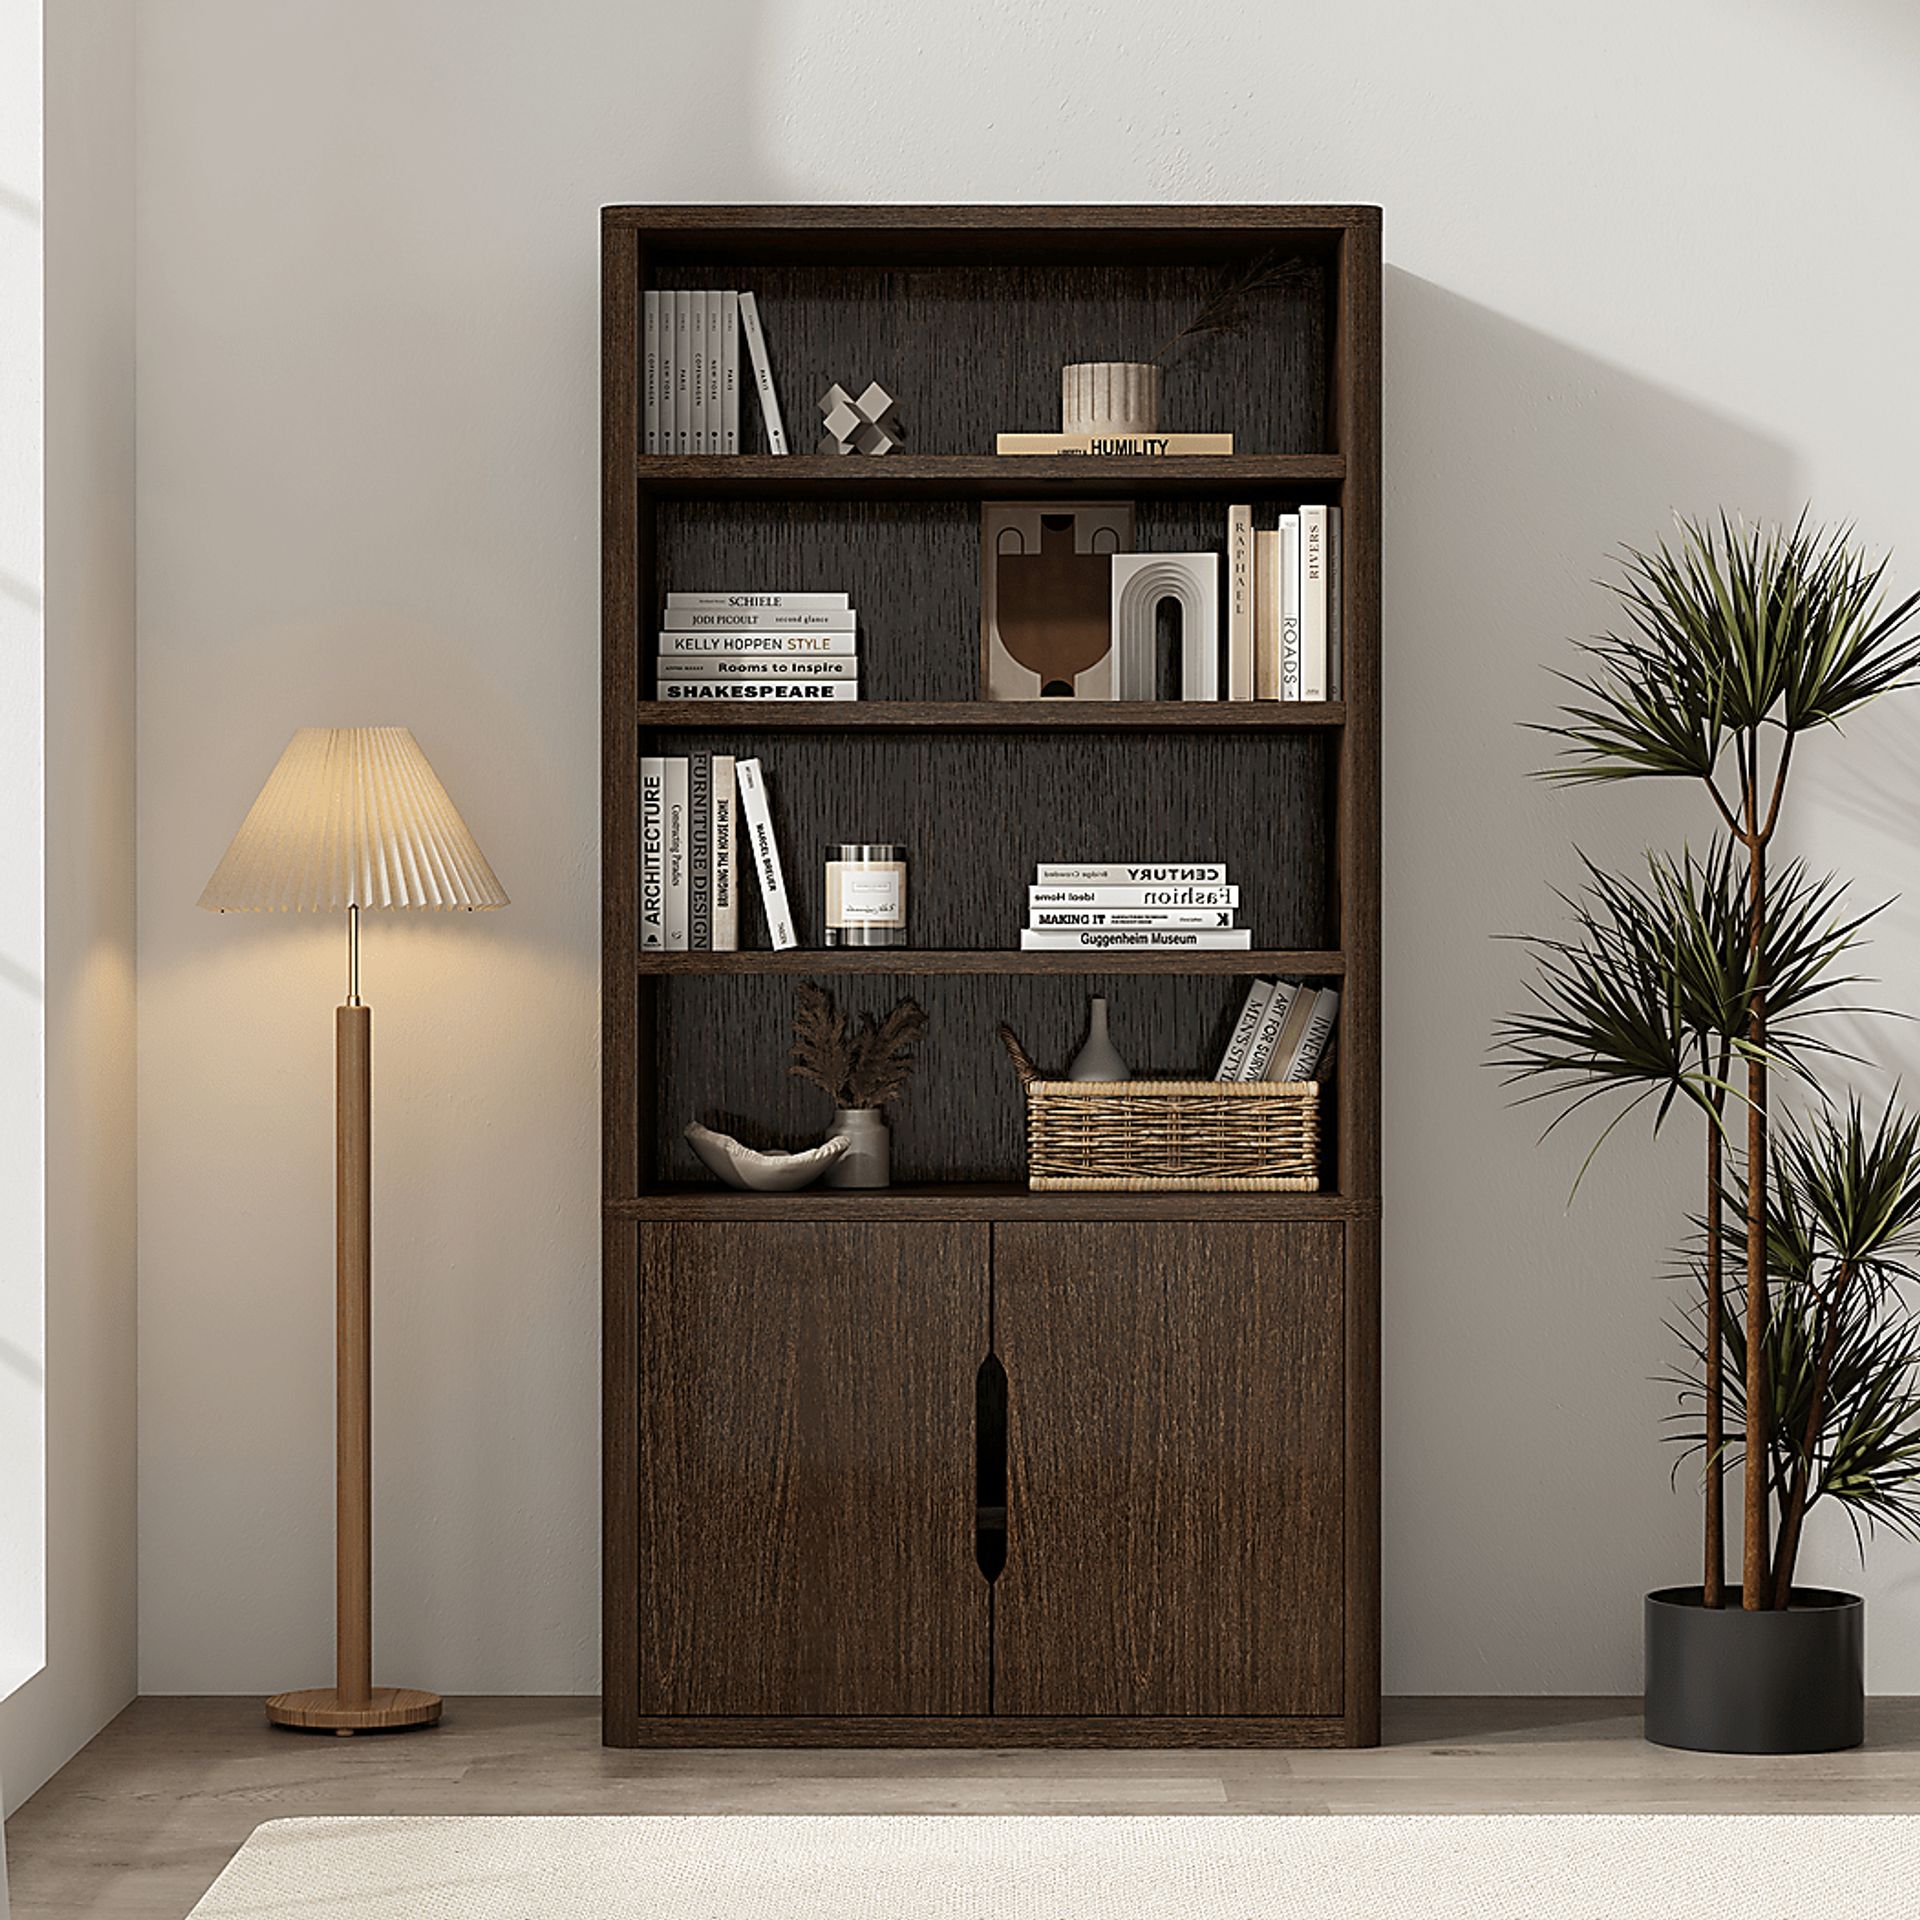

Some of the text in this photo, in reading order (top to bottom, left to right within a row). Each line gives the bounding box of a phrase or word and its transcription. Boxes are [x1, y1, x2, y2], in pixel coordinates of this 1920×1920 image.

[679, 369, 687, 391] PARIS
[760, 369, 769, 391] PARIS
[1091, 439, 1169, 456] HUMILITY
[1309, 524, 1320, 580] RIVERS
[1235, 522, 1246, 614] RAPHAEL
[728, 596, 782, 607] SCHIELE
[692, 615, 760, 626] JODI PICOULT
[775, 615, 829, 625] second glance
[674, 638, 831, 650] KELLY HOPPEN STYLE
[1283, 617, 1298, 685] ROADS
[718, 662, 843, 675] Rooms to Inspire
[667, 685, 834, 698] SHAKESPEARE
[644, 776, 661, 926] ARCHITECTURE
[693, 753, 707, 949] FURNITURE DESIGN
[717, 799, 729, 908] BRINGING THE HOUSE HOME
[756, 823, 777, 891] MARCEL BREUER
[1038, 914, 1090, 925] MAKING
[1092, 914, 1106, 925] IT
[1080, 932, 1197, 948] Guggenheim Museum
[1272, 993, 1290, 1018] ART
[1260, 1018, 1280, 1043] FOR
